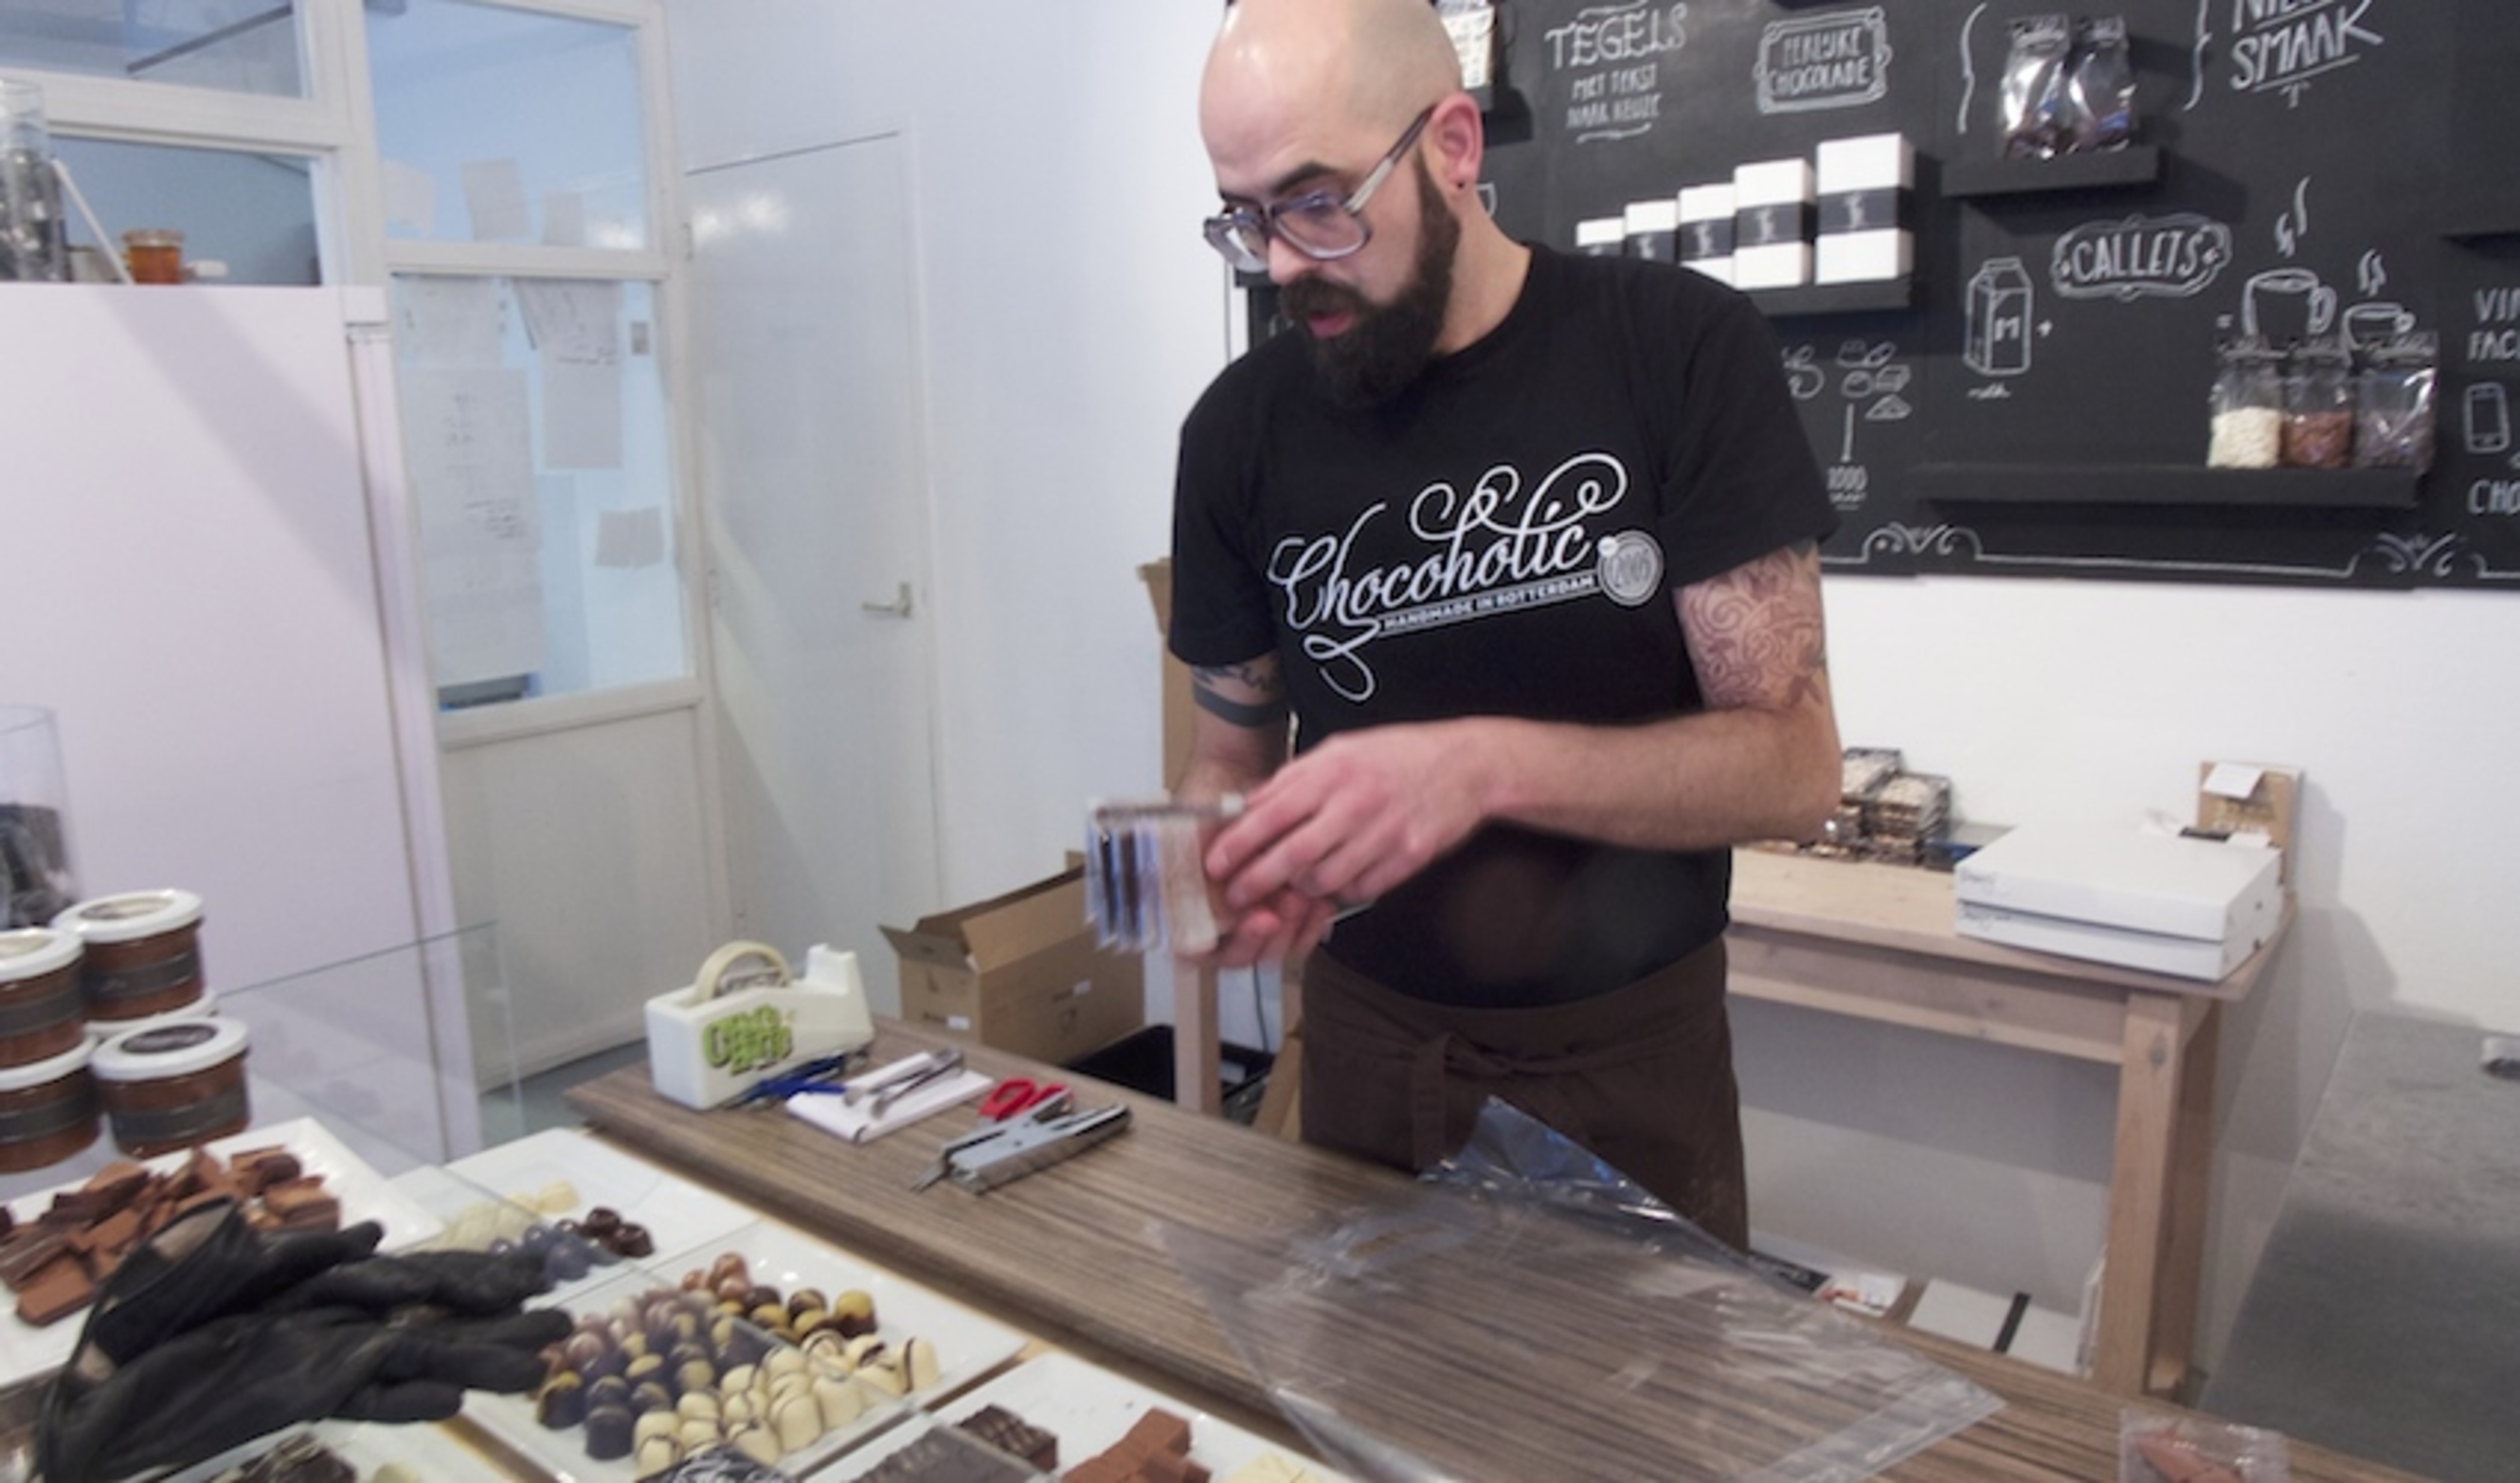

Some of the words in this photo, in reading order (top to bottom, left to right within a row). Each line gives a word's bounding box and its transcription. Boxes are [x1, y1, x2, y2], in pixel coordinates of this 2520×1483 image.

[1544, 2, 1688, 69] TEGELS
[2229, 0, 2384, 90] SMAAK
[1769, 56, 1870, 96] CHOCOLADE
[2072, 230, 2205, 282] CALLETS
[2467, 329, 2520, 361] FAC
[1268, 452, 1629, 702] Chocoholic
[1384, 600, 1473, 630] HANDMADE
[1475, 594, 1493, 610] IN
[1495, 573, 1594, 607] ROTTERDAM
